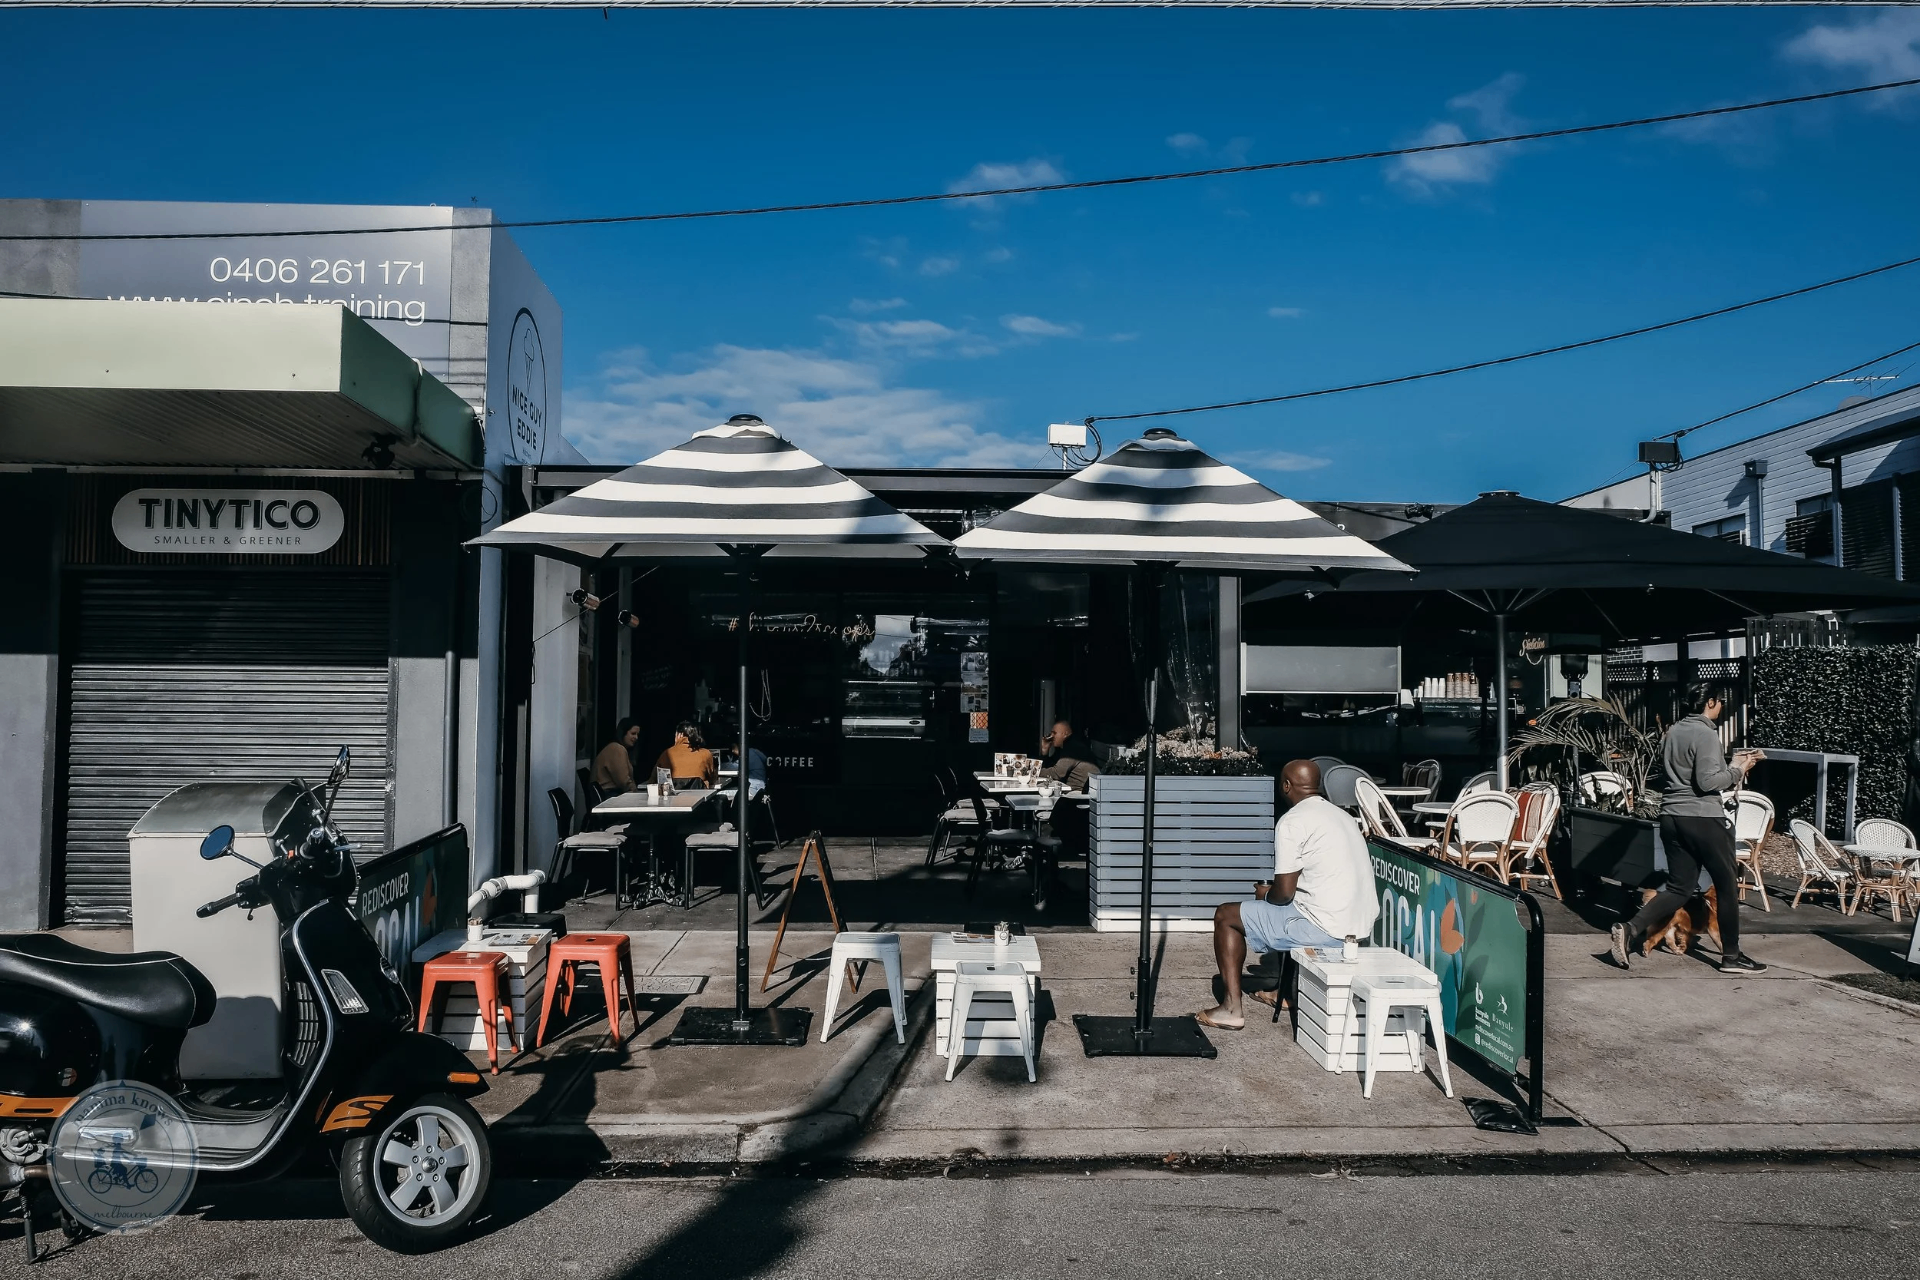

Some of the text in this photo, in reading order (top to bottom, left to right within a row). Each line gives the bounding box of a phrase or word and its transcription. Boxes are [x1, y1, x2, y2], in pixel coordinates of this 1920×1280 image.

[210, 257, 424, 286] 0406 261 171
[512, 384, 542, 428] NICE GUY
[517, 417, 537, 450] EDDIE
[138, 498, 321, 531] TINYTICO
[154, 535, 301, 546] SMALLER & GREENER
[361, 871, 409, 918] REDISCOVER
